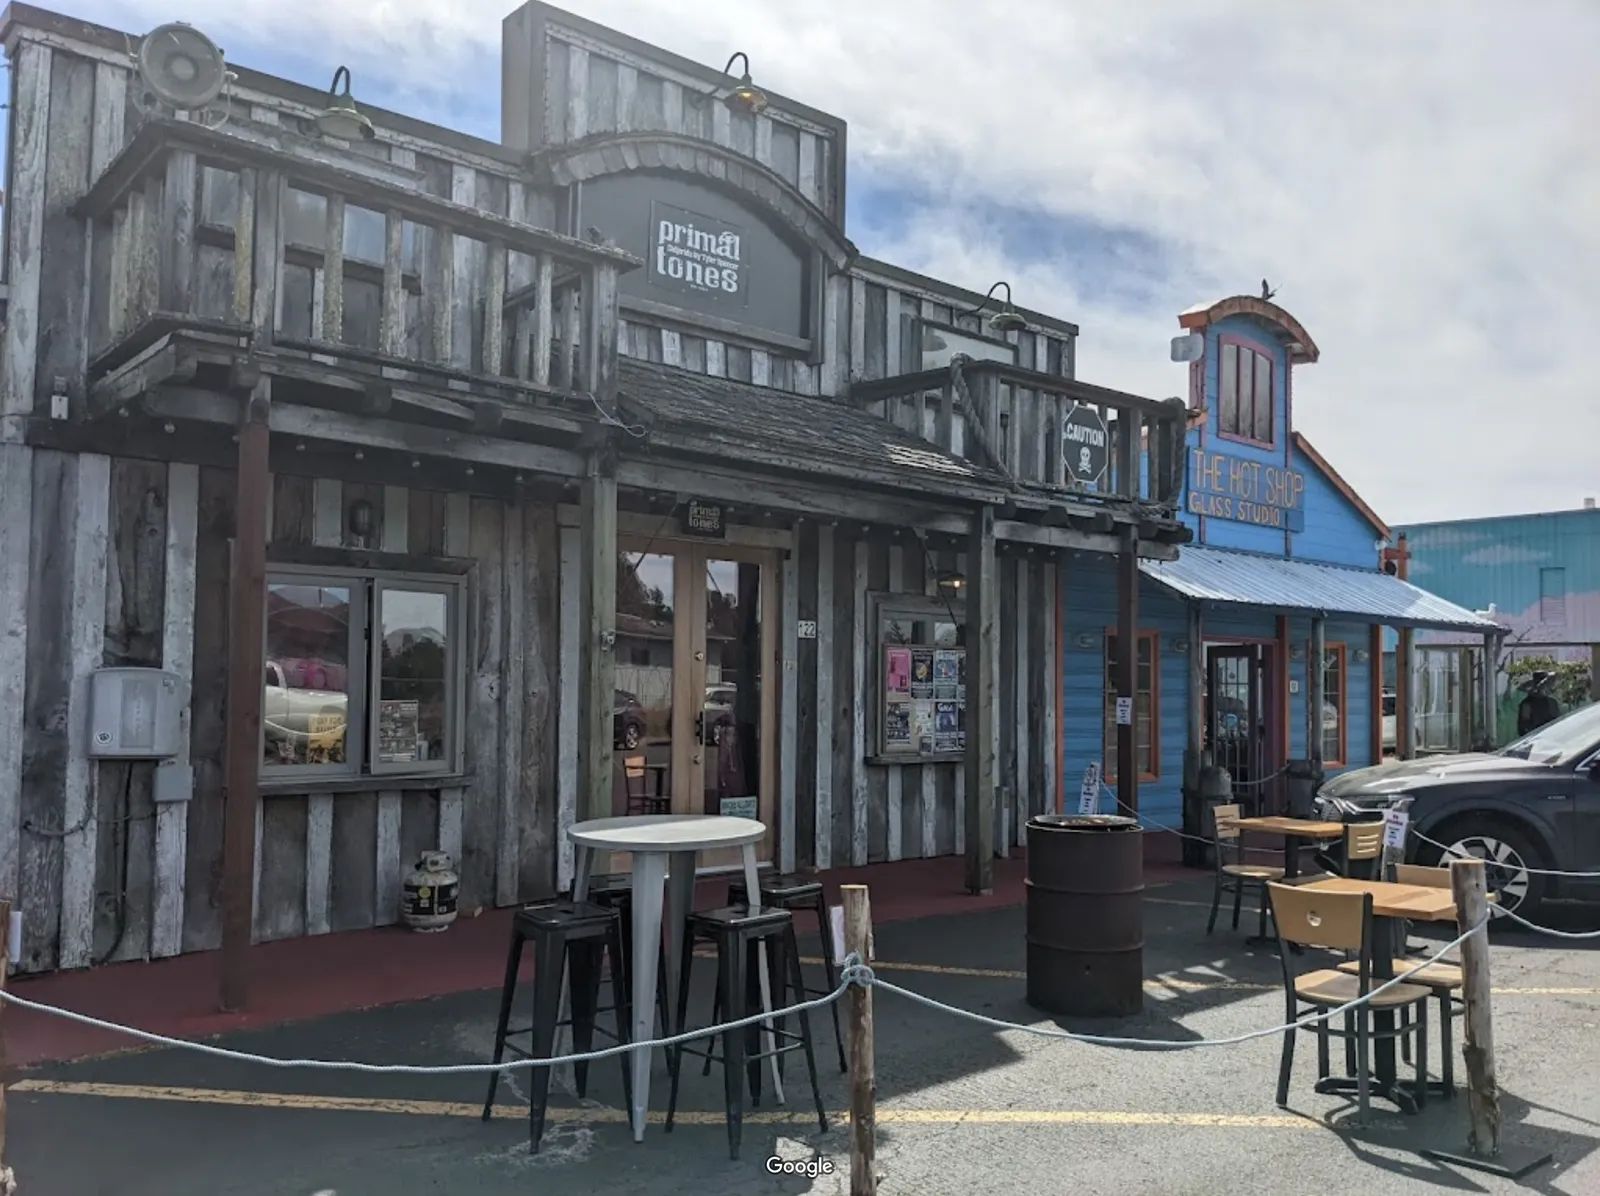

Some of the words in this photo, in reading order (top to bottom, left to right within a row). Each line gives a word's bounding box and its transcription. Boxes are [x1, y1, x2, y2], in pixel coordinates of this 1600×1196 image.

[659, 220, 740, 261] primal
[657, 245, 738, 293] tones
[1067, 423, 1104, 447] CAUTION
[1193, 450, 1225, 492] THE
[1230, 458, 1261, 500] HOT
[1265, 467, 1304, 508] SHOP
[1188, 491, 1232, 518] GLASS
[1238, 501, 1280, 526] STUDIO
